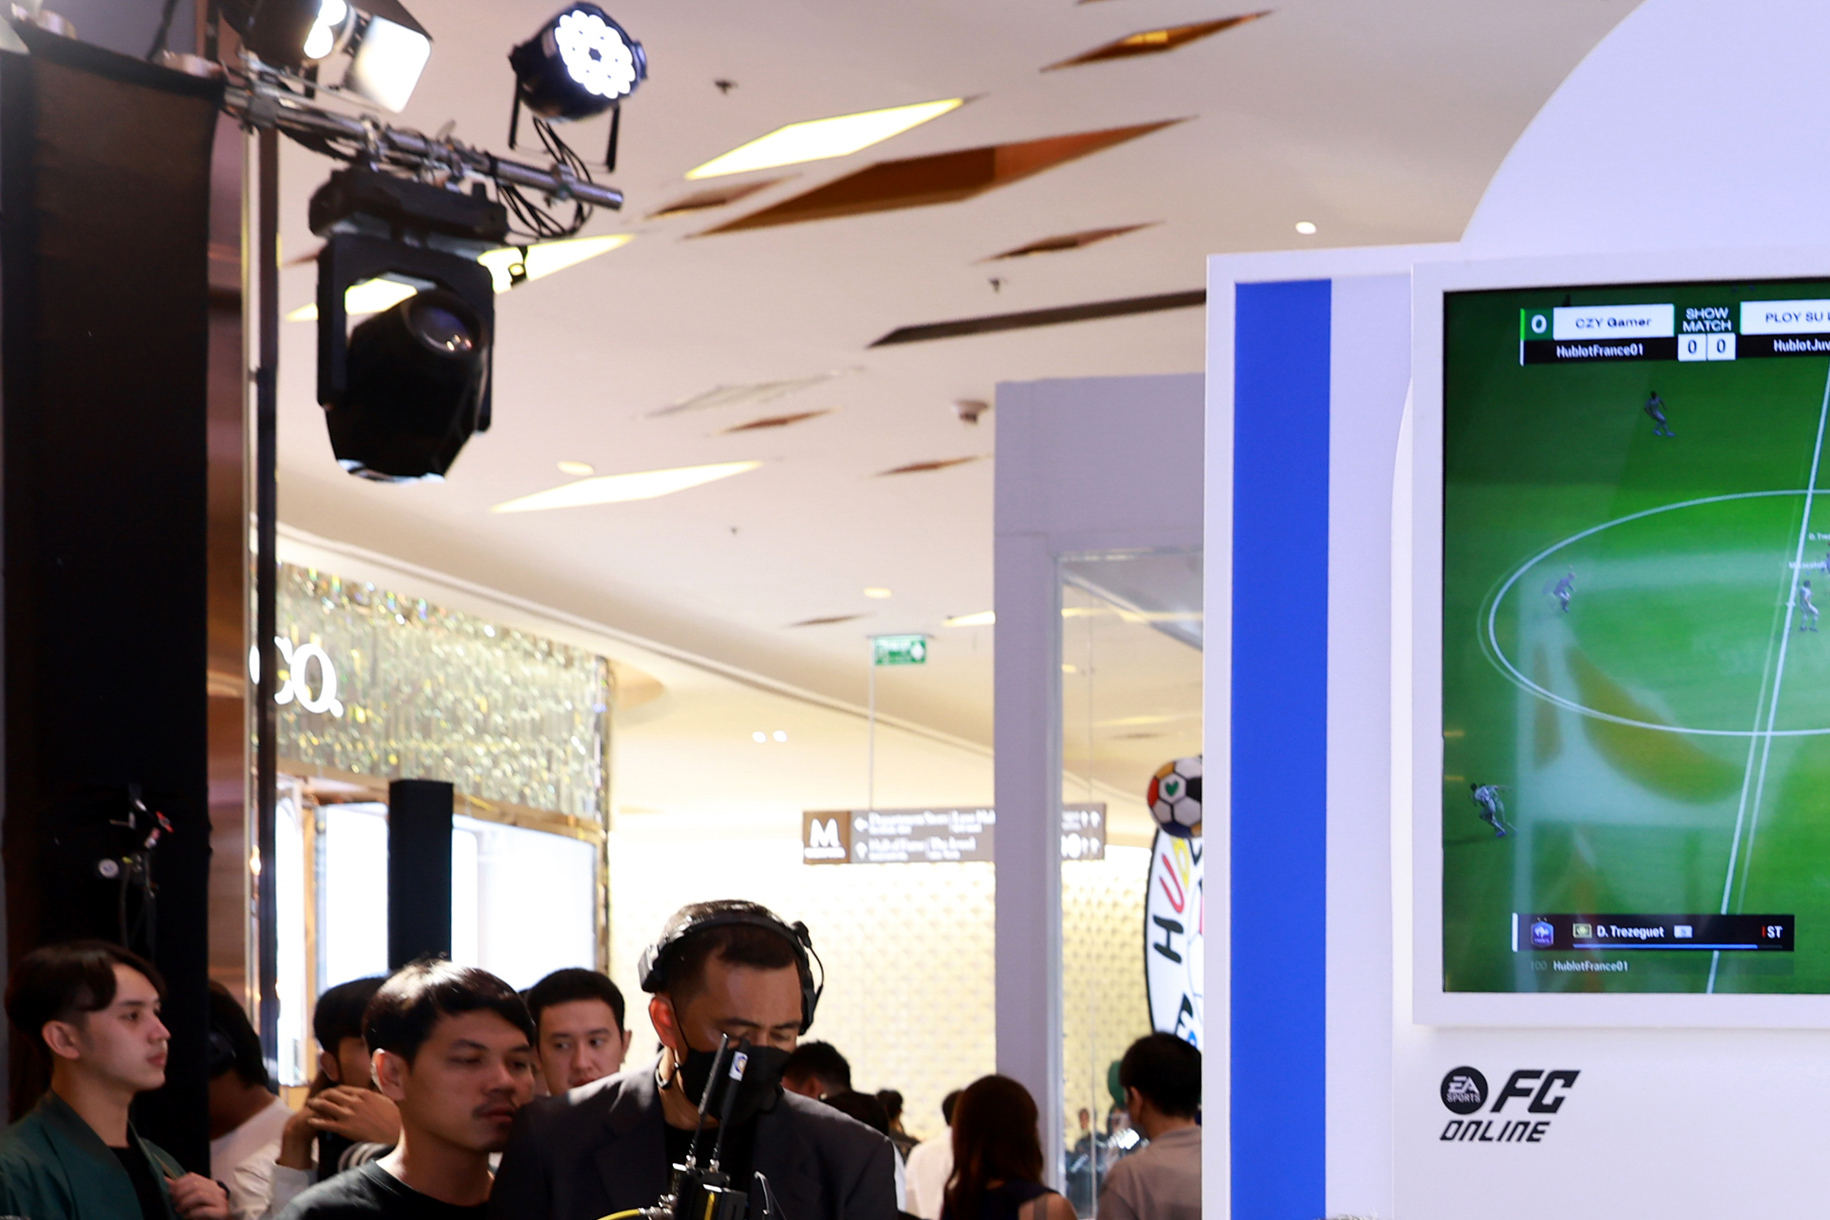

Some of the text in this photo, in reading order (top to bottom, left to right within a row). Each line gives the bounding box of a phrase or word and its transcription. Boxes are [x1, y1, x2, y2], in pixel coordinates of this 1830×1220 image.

[1685, 307, 1729, 320] SHOW
[1765, 312, 1802, 324] PLOY
[1805, 312, 1825, 323] SU
[1531, 314, 1548, 334] 0
[1575, 316, 1652, 329] CZY Gamer
[1682, 319, 1732, 333] MATCH
[1556, 342, 1644, 359] HublotFrance01
[1688, 340, 1697, 354] 0
[1716, 339, 1726, 353] 0
[809, 817, 840, 848] M
[1596, 925, 1609, 938] D.
[1610, 925, 1665, 939] Trezeguet
[1766, 925, 1783, 939] ST
[1553, 960, 1629, 972] HublotFrance01
[1447, 1075, 1480, 1094] EA
[1490, 1069, 1581, 1113] FC
[1446, 1093, 1481, 1103] SPORTS
[1439, 1120, 1551, 1142] ONLINE
